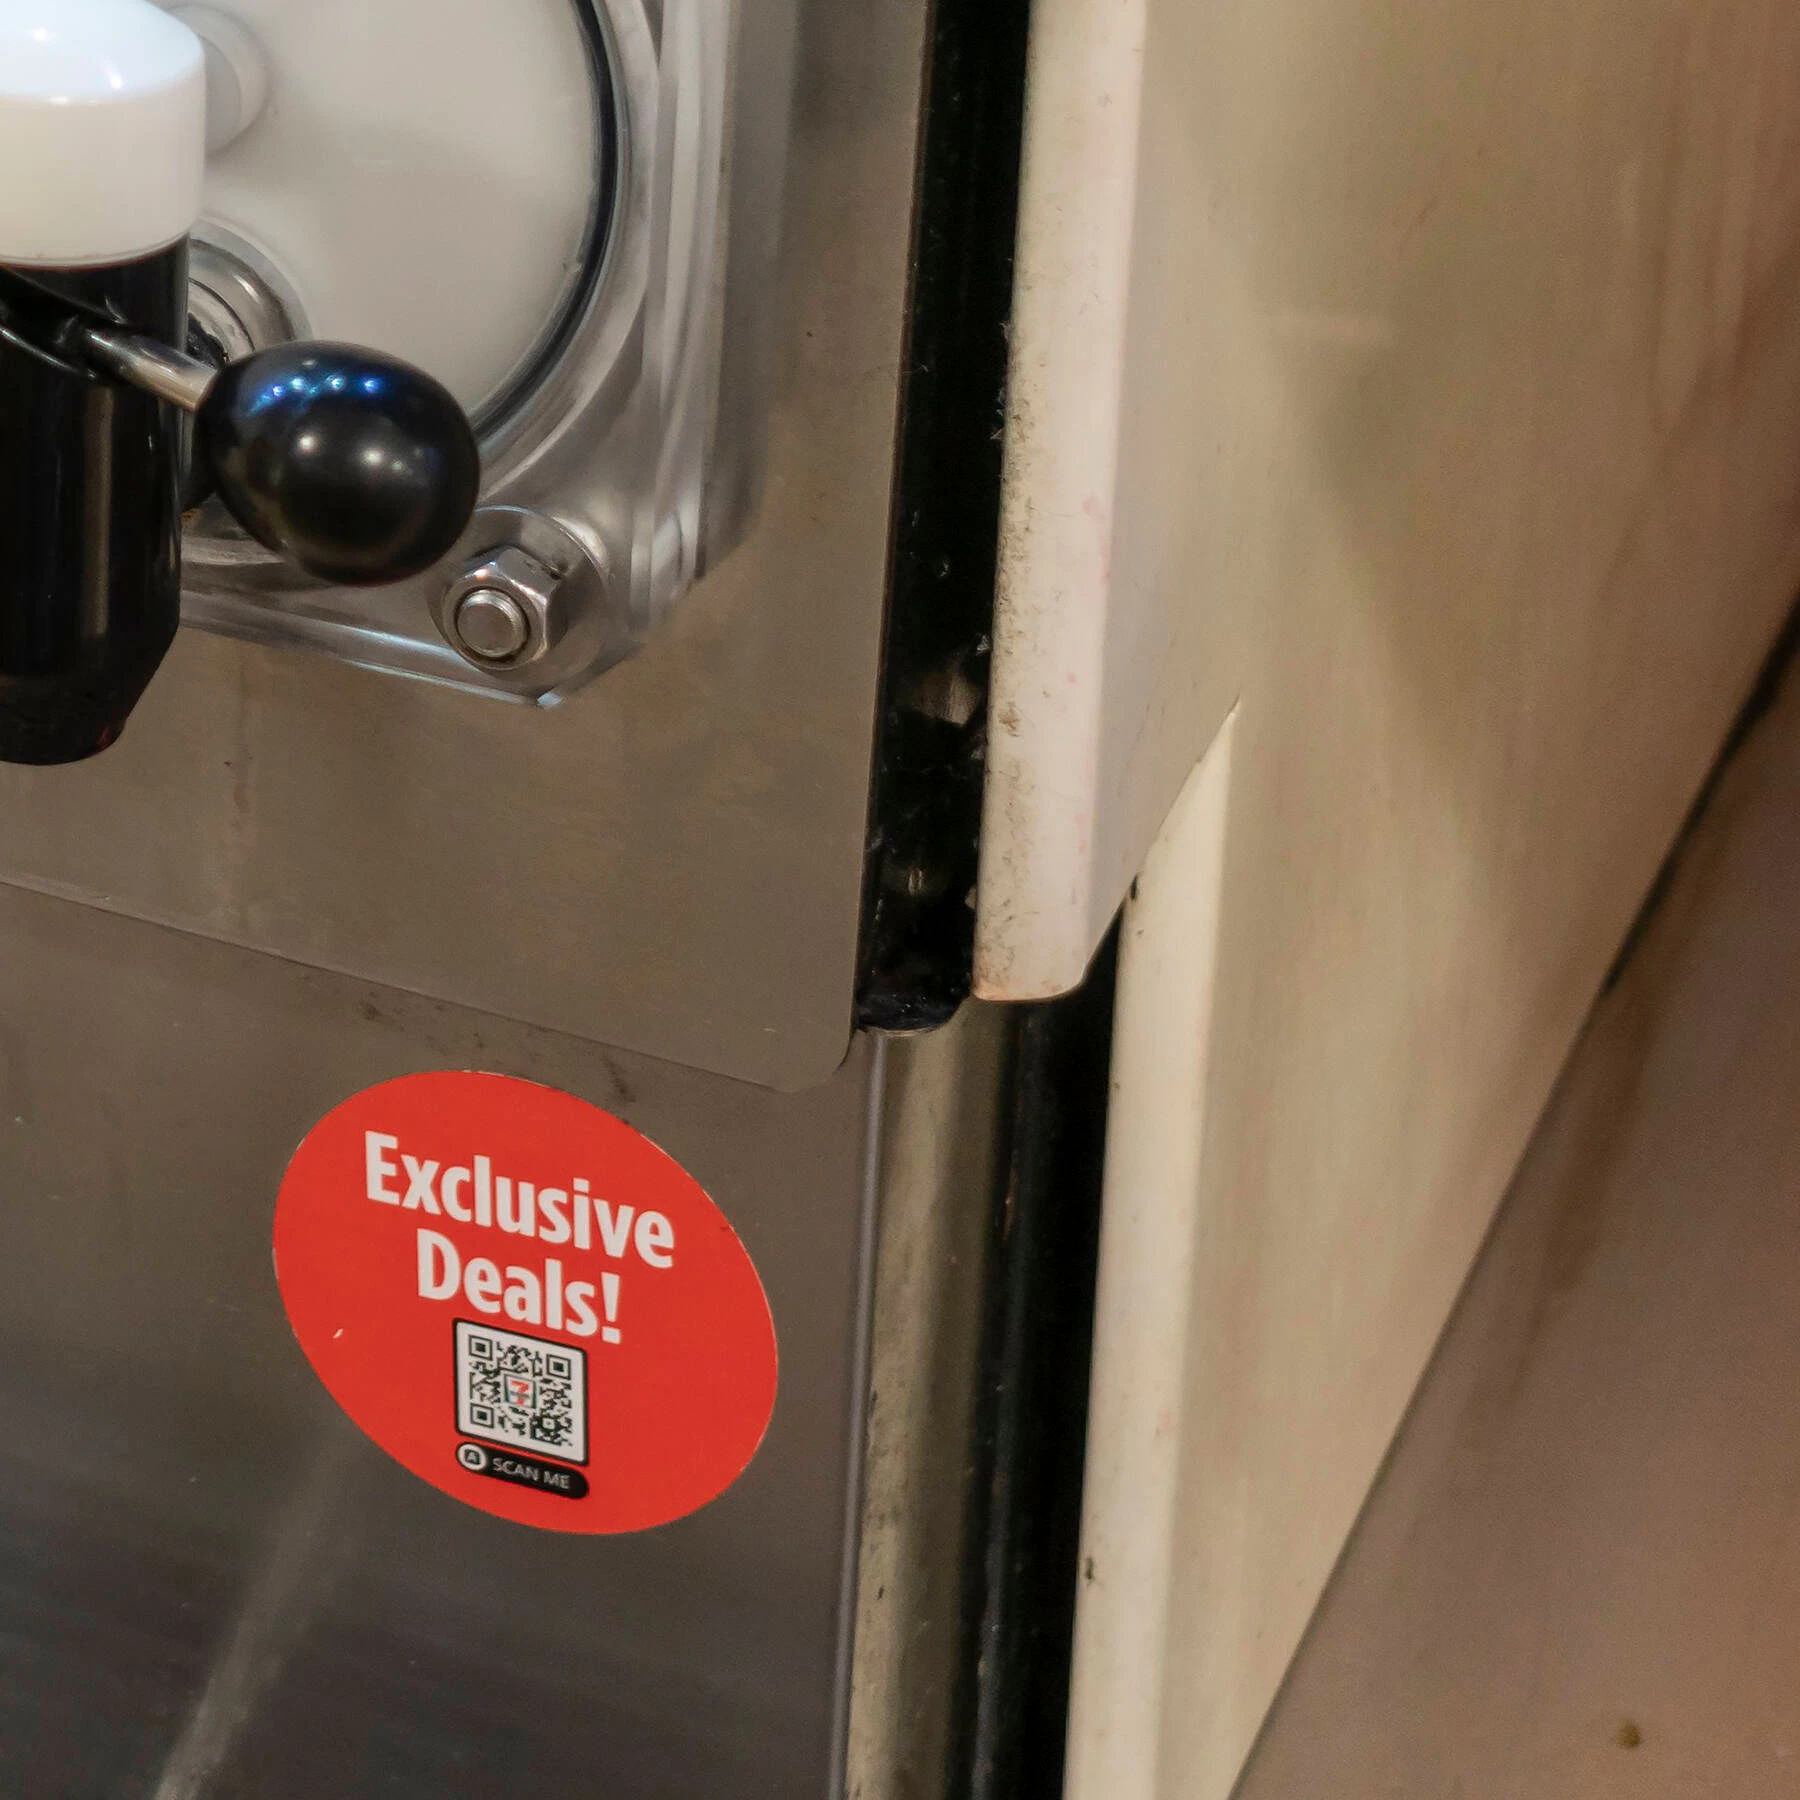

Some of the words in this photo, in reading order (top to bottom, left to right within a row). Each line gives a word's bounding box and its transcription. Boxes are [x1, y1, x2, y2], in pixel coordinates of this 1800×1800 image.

[365, 1130, 674, 1269] Exclusive
[417, 1228, 621, 1344] Deals!
[493, 1457, 540, 1482] SCAN
[544, 1471, 571, 1490] ME
